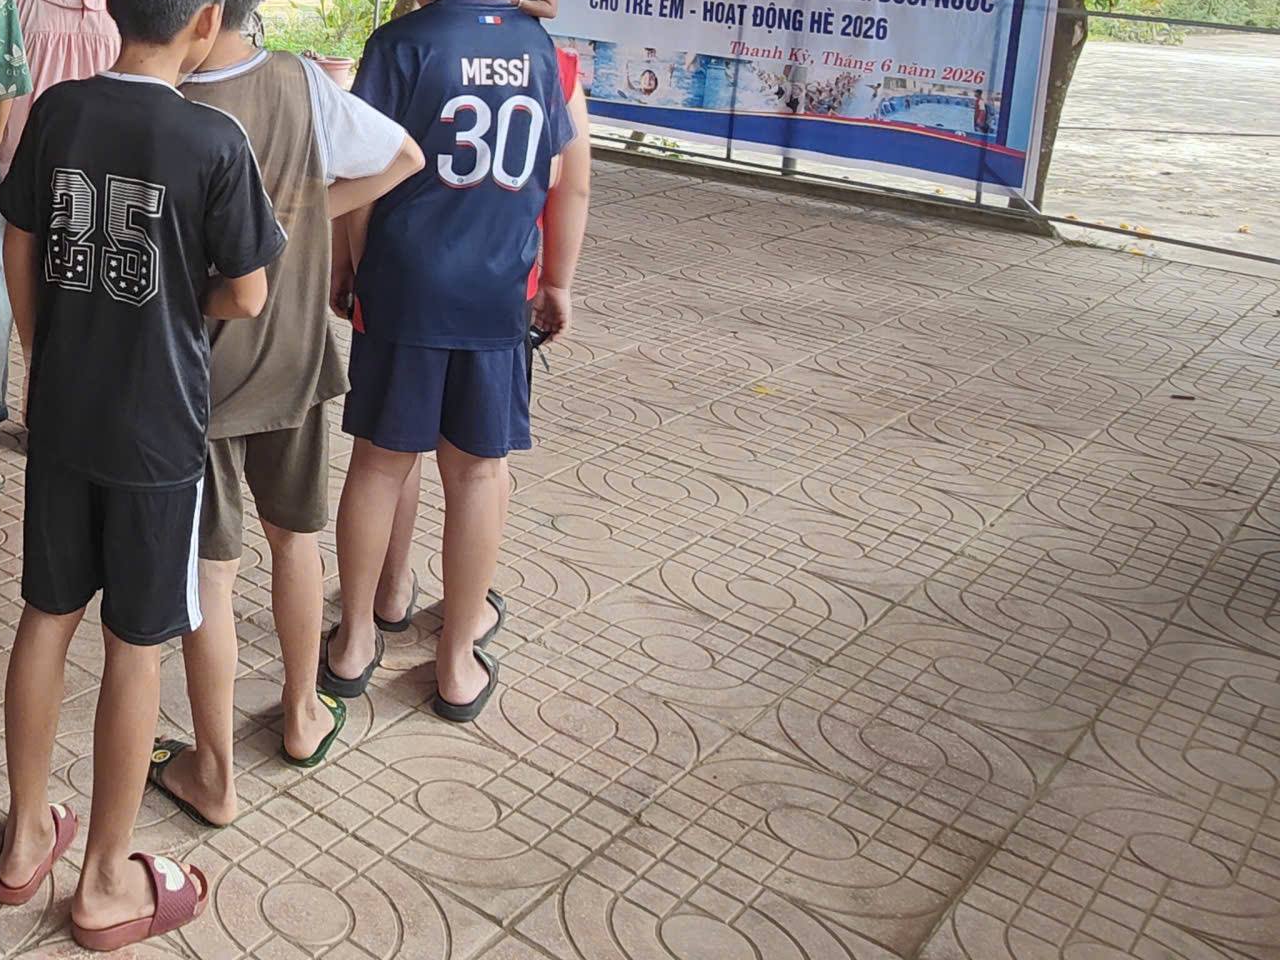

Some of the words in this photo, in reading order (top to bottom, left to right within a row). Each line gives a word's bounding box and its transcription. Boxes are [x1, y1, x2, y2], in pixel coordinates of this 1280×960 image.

[702, 0, 748, 29] HOẠT
[752, 2, 804, 34] ĐỘNG
[809, 7, 835, 35] HÈ
[840, 14, 889, 41] 2026
[729, 40, 783, 60] Thanh
[822, 51, 877, 73] Tháng
[880, 58, 893, 72] 6
[896, 62, 937, 79] năm
[941, 66, 986, 84] 2026
[437, 95, 544, 192] 30
